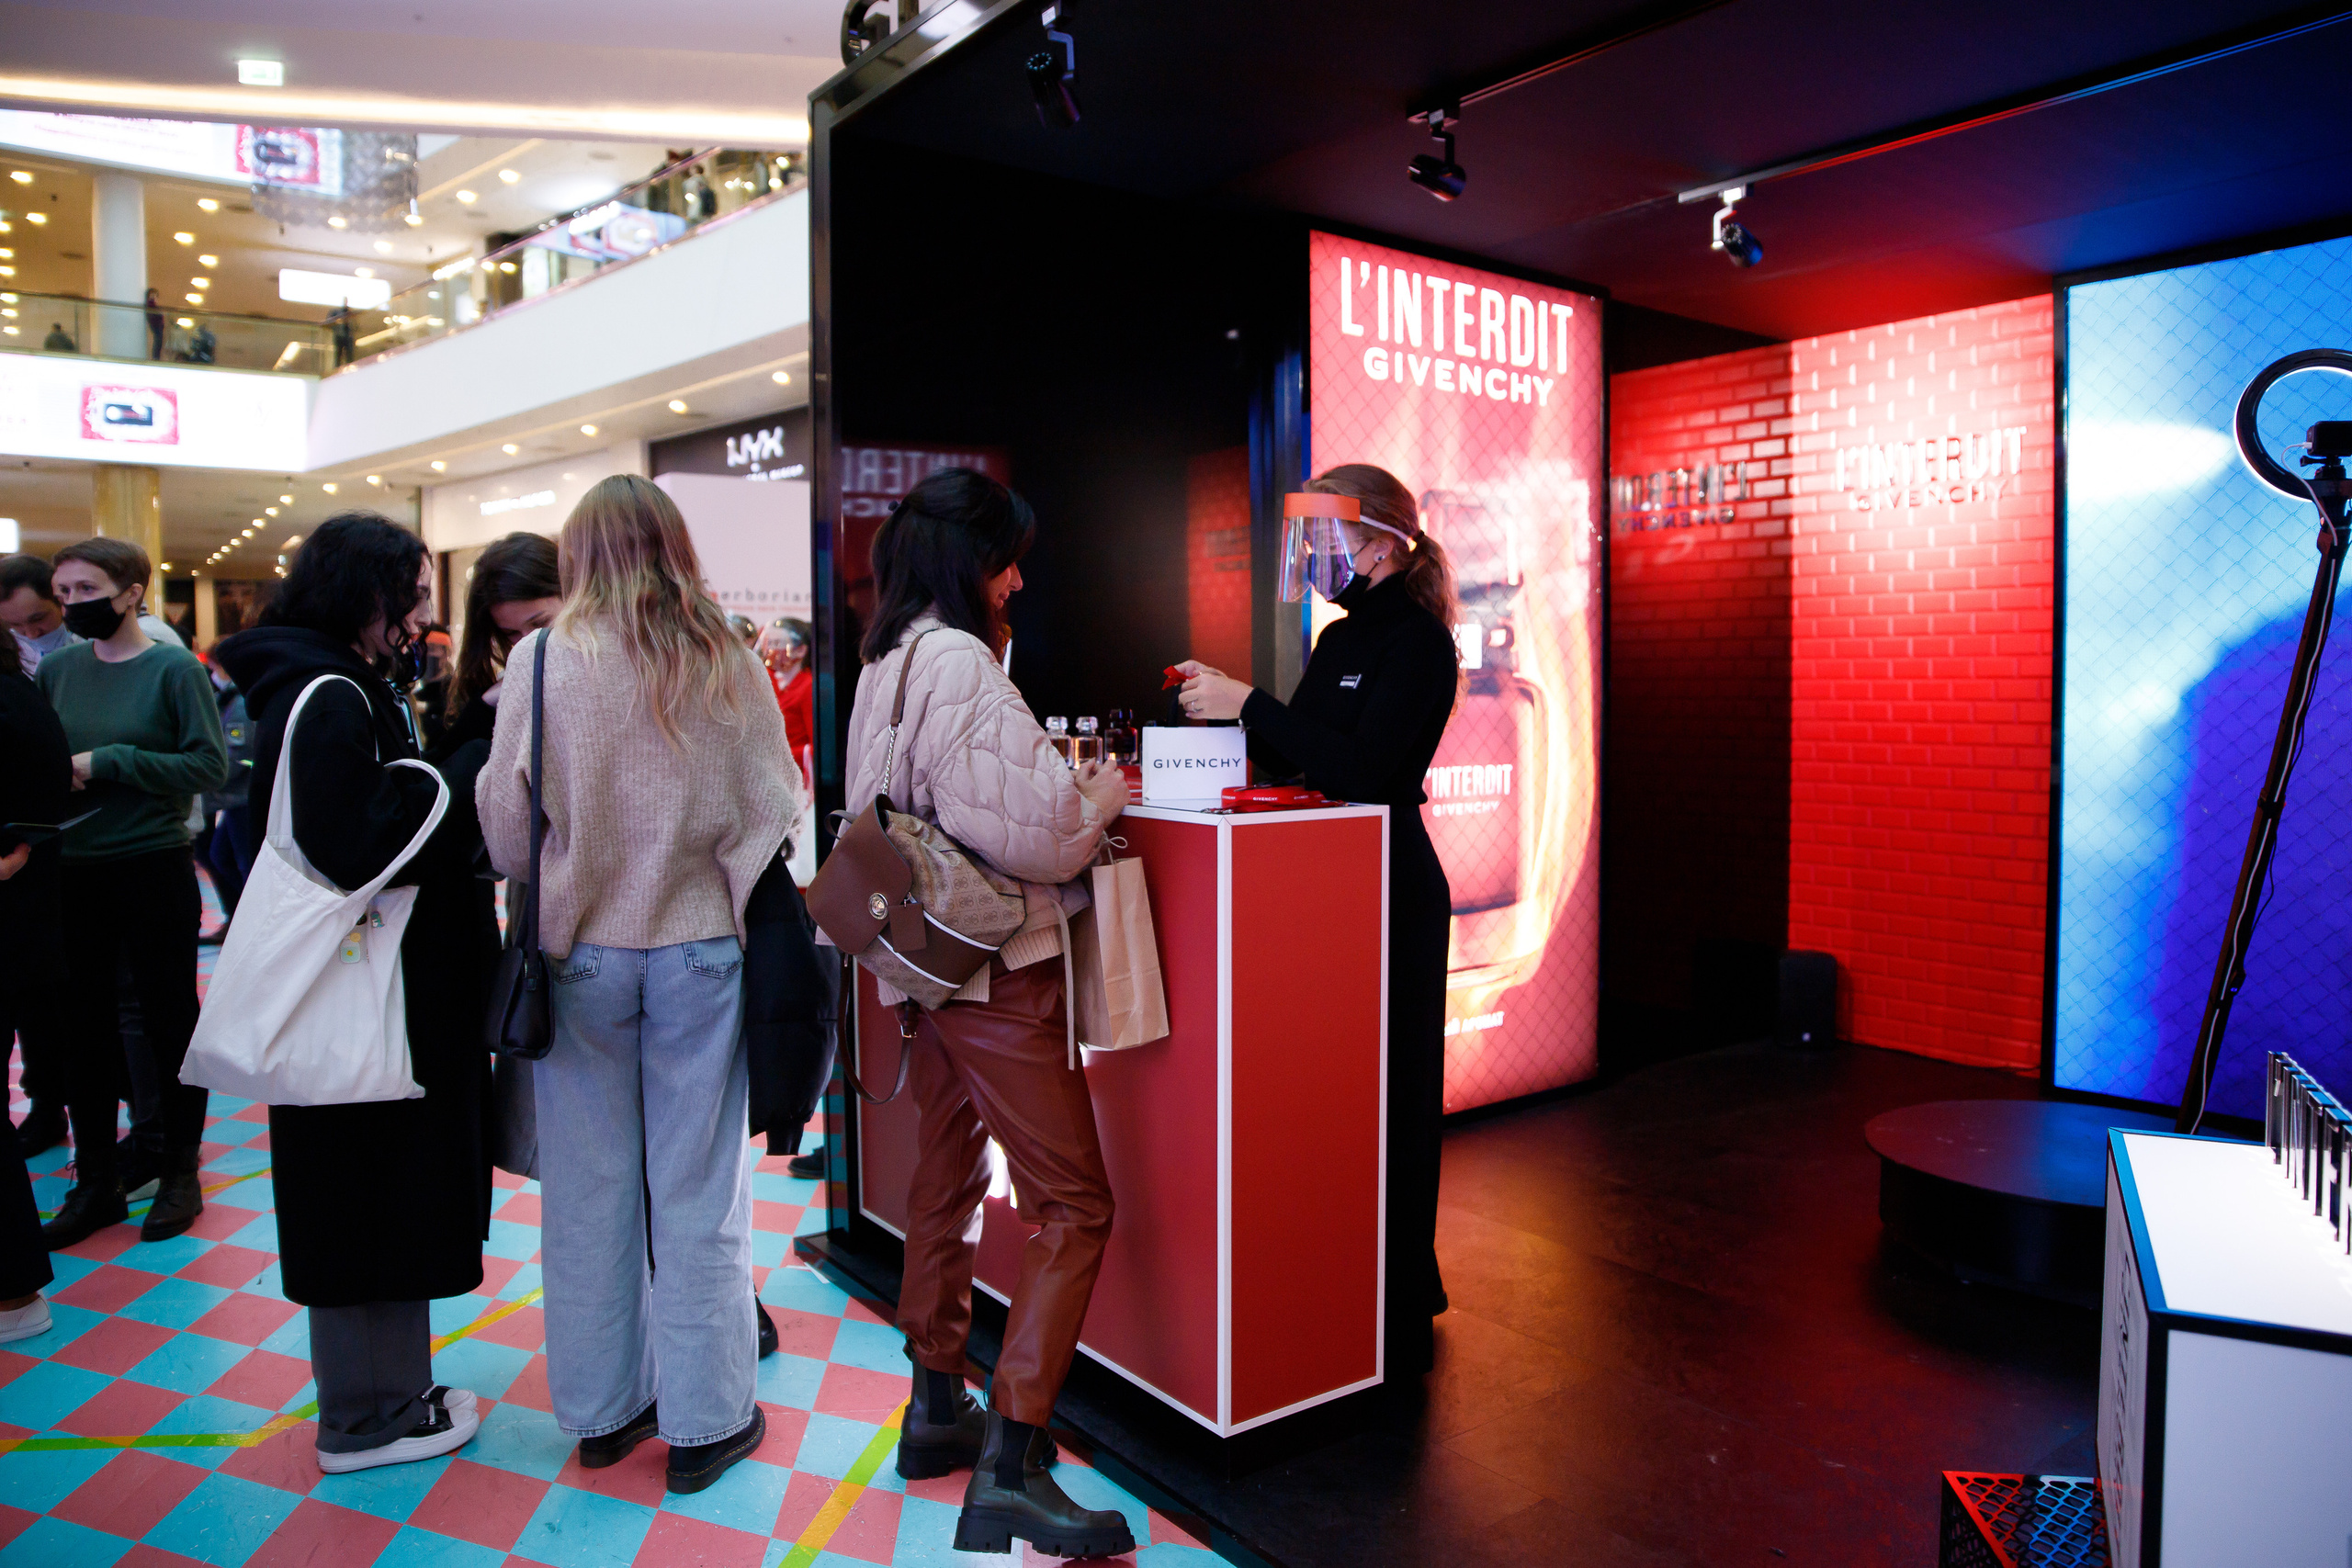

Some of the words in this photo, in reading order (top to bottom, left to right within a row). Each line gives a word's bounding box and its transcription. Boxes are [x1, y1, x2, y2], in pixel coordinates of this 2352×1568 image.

[1340, 256, 1574, 375] L'INTERDIT
[1363, 346, 1555, 407] GIVENCHY
[727, 425, 784, 467] NYX
[1849, 479, 2009, 513] GIVENCHY
[1153, 758, 1241, 769] GIVENCHY
[1425, 764, 1513, 798] 'INTERDIT
[1432, 801, 1500, 818] GIVENCHY
